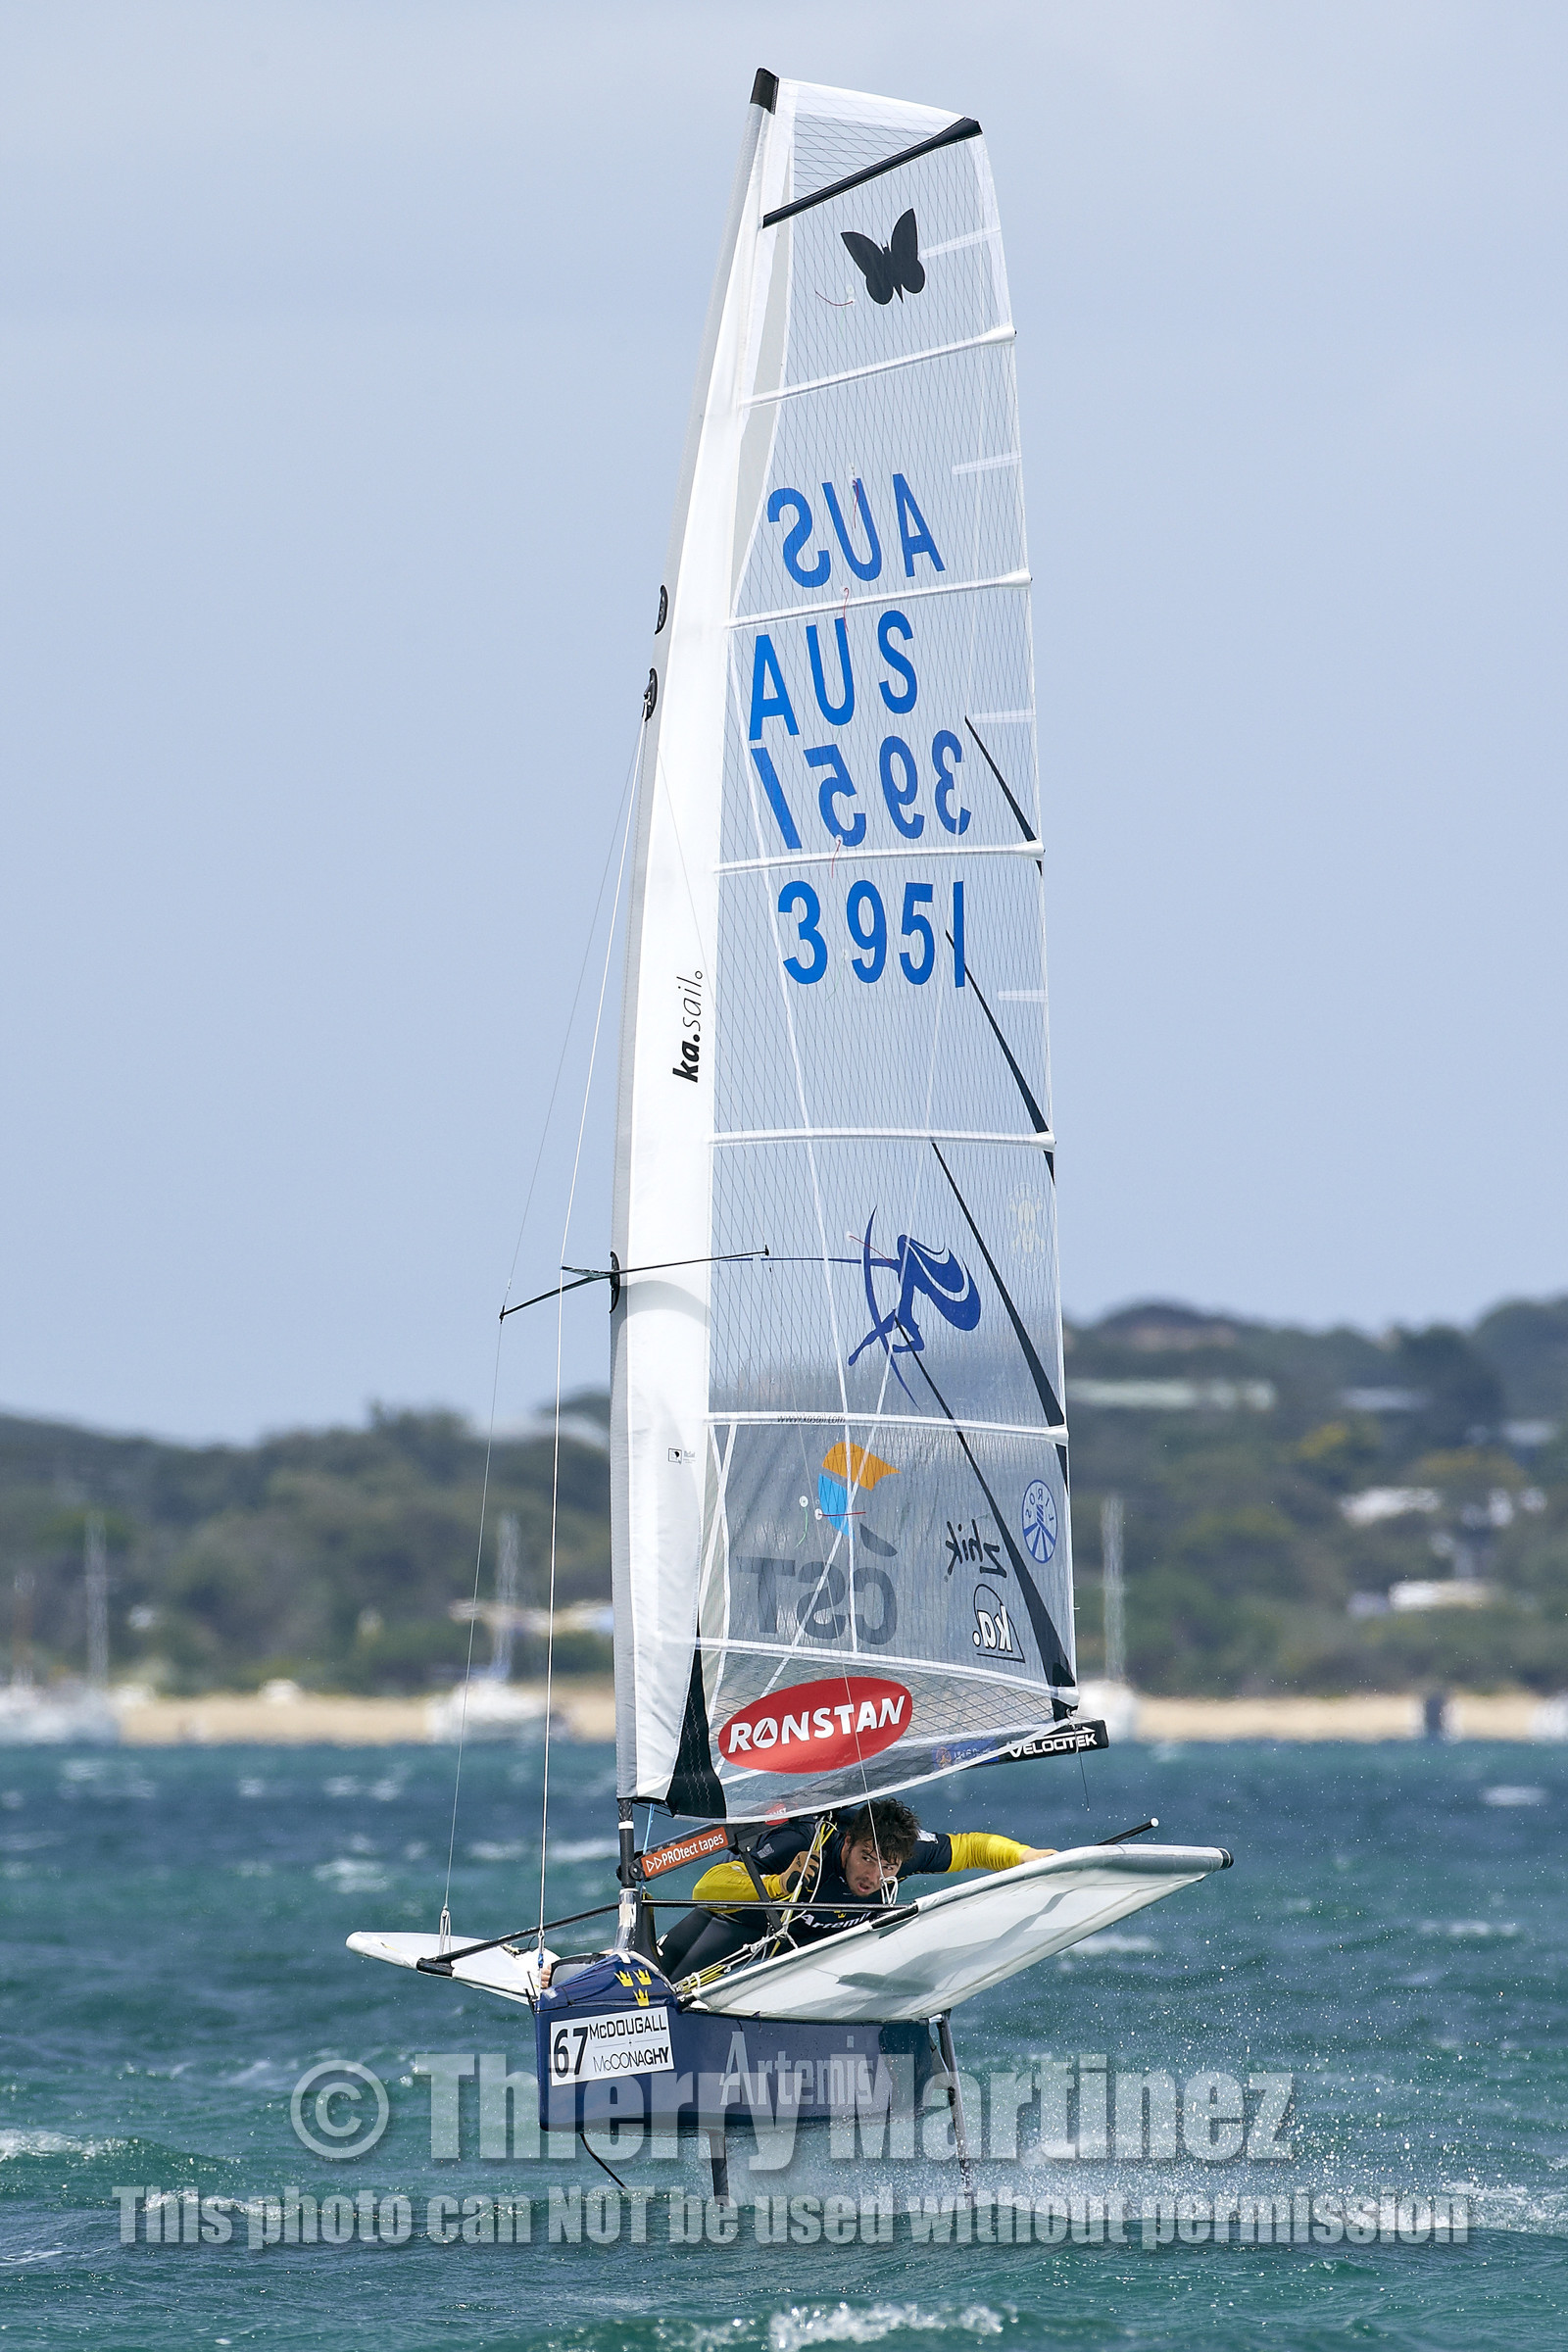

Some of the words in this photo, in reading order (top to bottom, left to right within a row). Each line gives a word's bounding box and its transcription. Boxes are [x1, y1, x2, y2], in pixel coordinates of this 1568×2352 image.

[749, 610, 918, 742] AUS
[778, 880, 965, 987] 3951
[728, 1695, 906, 1754] RONSTAN
[1007, 1733, 1098, 1758] VELOCITEK
[662, 1843, 699, 1866] PROtect
[698, 1834, 724, 1851] tapes
[554, 2027, 589, 2078] 67
[589, 2015, 667, 2039] McDOUGALL
[593, 2046, 669, 2073] McCONAGHY
[719, 2031, 874, 2106] Artemis
